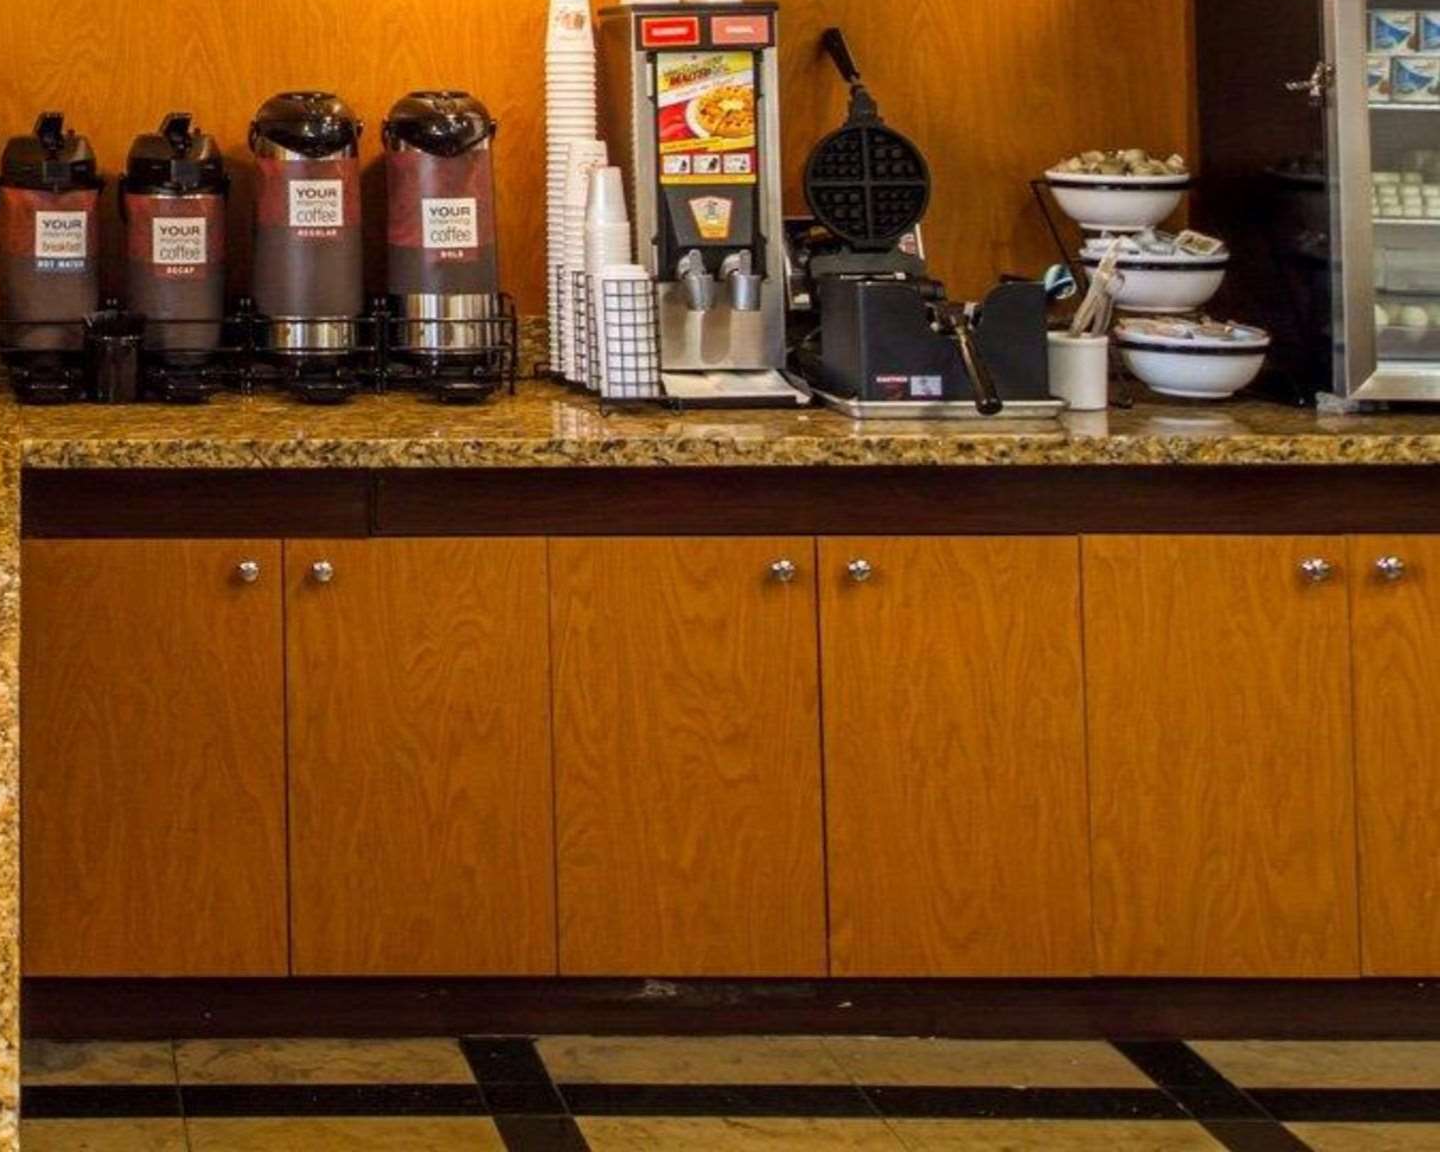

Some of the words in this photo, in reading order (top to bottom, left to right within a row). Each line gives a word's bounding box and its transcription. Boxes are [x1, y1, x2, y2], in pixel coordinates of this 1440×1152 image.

[295, 188, 337, 199] YOUR
[295, 208, 337, 223] coffee
[429, 206, 471, 217] YOUR
[41, 219, 82, 229] YOUR
[160, 225, 200, 236] YOUR
[430, 226, 472, 243] coffee
[160, 245, 200, 260] coffee
